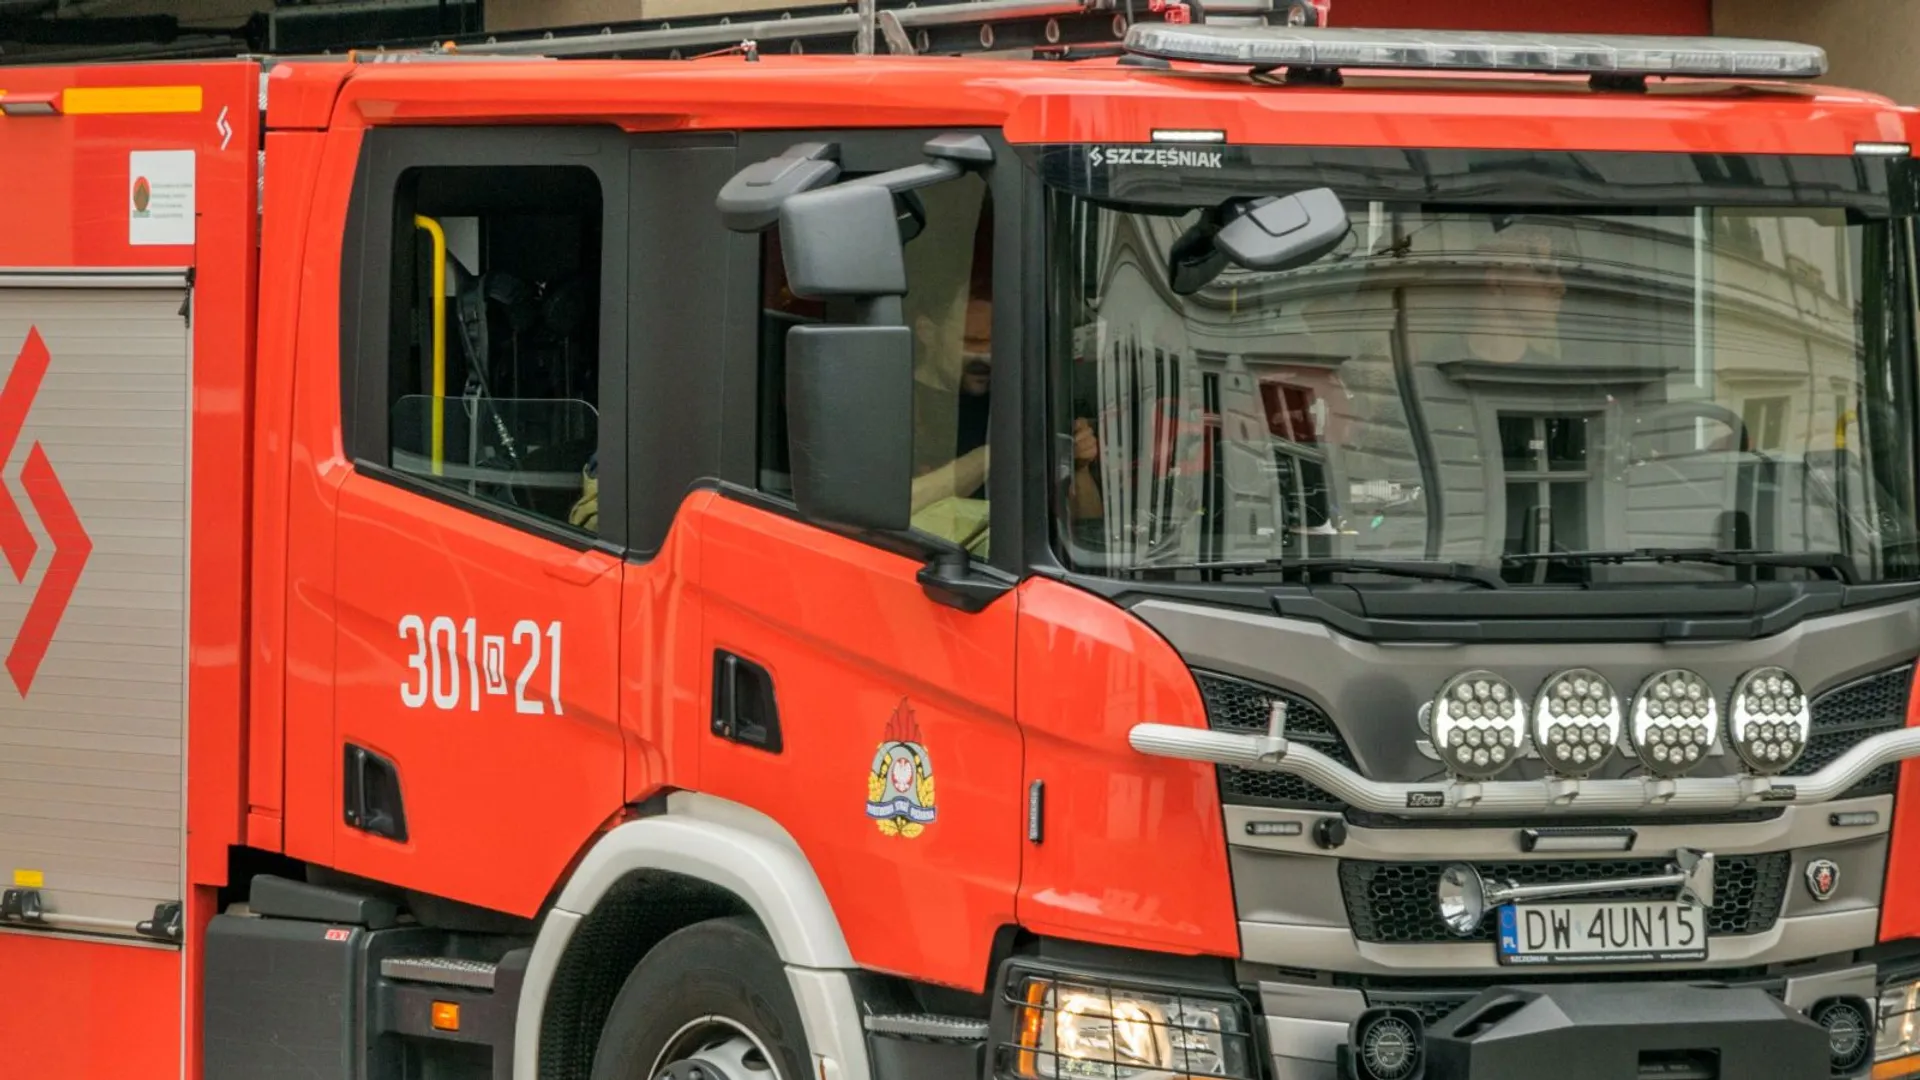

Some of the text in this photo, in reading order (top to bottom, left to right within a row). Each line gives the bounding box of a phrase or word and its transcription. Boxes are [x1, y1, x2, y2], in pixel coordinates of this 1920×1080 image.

[1105, 147, 1222, 168] SZCZĘŚNIAK
[1525, 906, 1695, 950] DW 4UN15
[1503, 936, 1516, 948] PL
